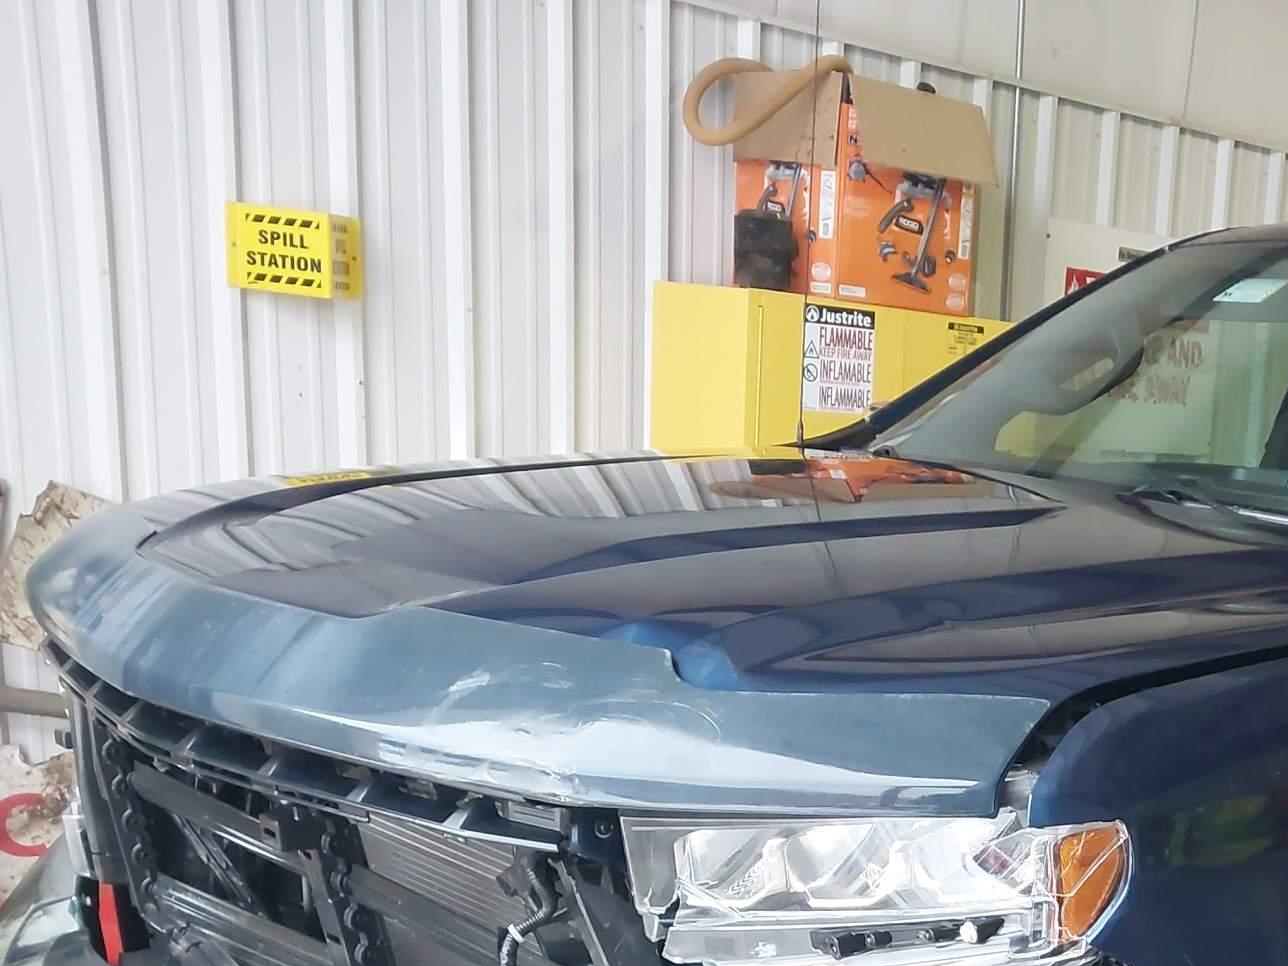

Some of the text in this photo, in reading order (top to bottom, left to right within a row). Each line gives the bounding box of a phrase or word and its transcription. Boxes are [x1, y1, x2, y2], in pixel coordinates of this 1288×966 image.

[258, 229, 309, 249] SPILL
[246, 250, 322, 274] STATION
[820, 308, 873, 328] Justrite
[819, 326, 873, 350] FLAMMABLE
[819, 347, 872, 361] KEEP FIRE AWAY
[819, 359, 871, 384] INFLAMABLE
[818, 386, 871, 409] INFLAMMABLE
